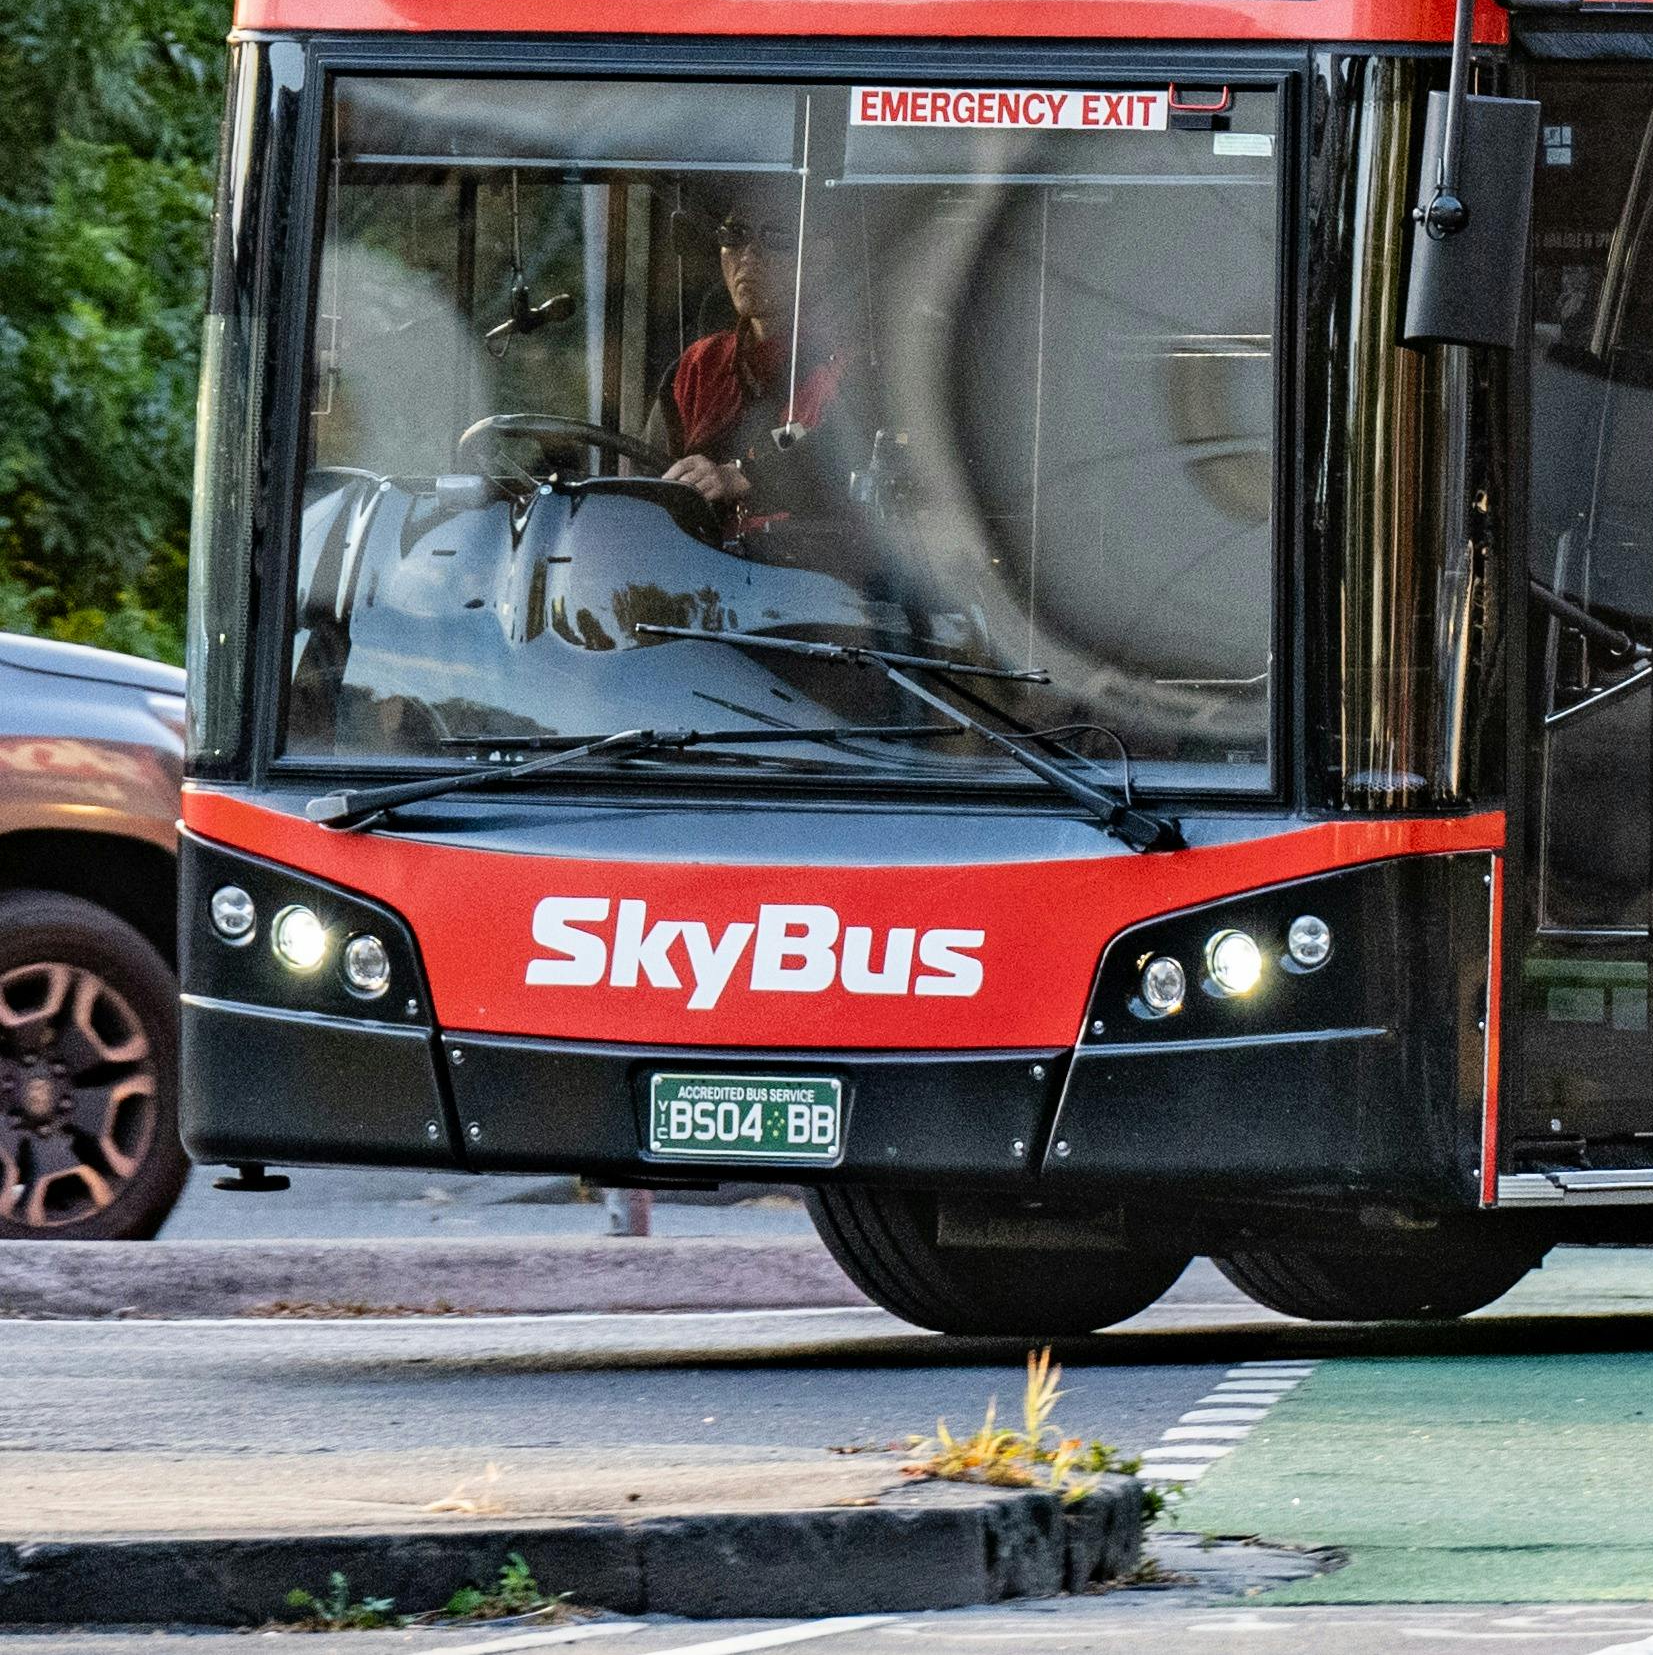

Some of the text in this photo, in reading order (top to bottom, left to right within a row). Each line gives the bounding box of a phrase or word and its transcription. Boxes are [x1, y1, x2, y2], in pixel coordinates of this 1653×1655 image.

[859, 90, 1158, 127] EMERGENCY EXIT
[525, 896, 986, 1010] SkyBus
[678, 1086, 815, 1103] ACCREDITED BUS SERVICE
